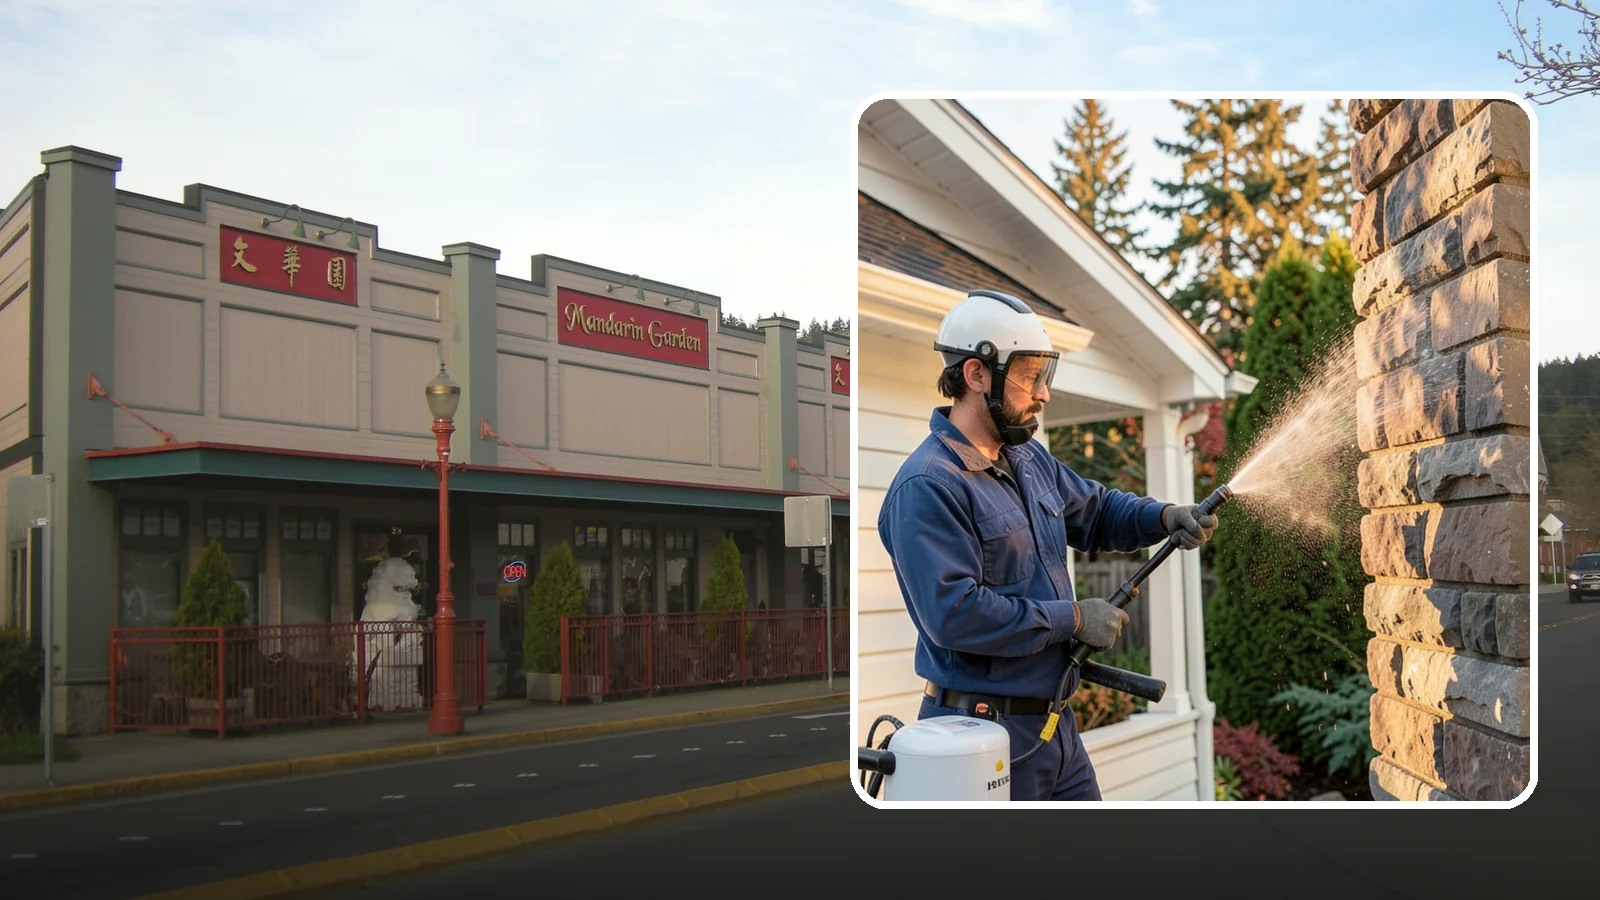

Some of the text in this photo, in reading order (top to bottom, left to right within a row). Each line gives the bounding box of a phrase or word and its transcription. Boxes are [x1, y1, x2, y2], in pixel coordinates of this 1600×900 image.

[231, 236, 346, 291] 文華園
[565, 302, 701, 352] Mandarin Garden
[503, 565, 527, 578] OPEN
